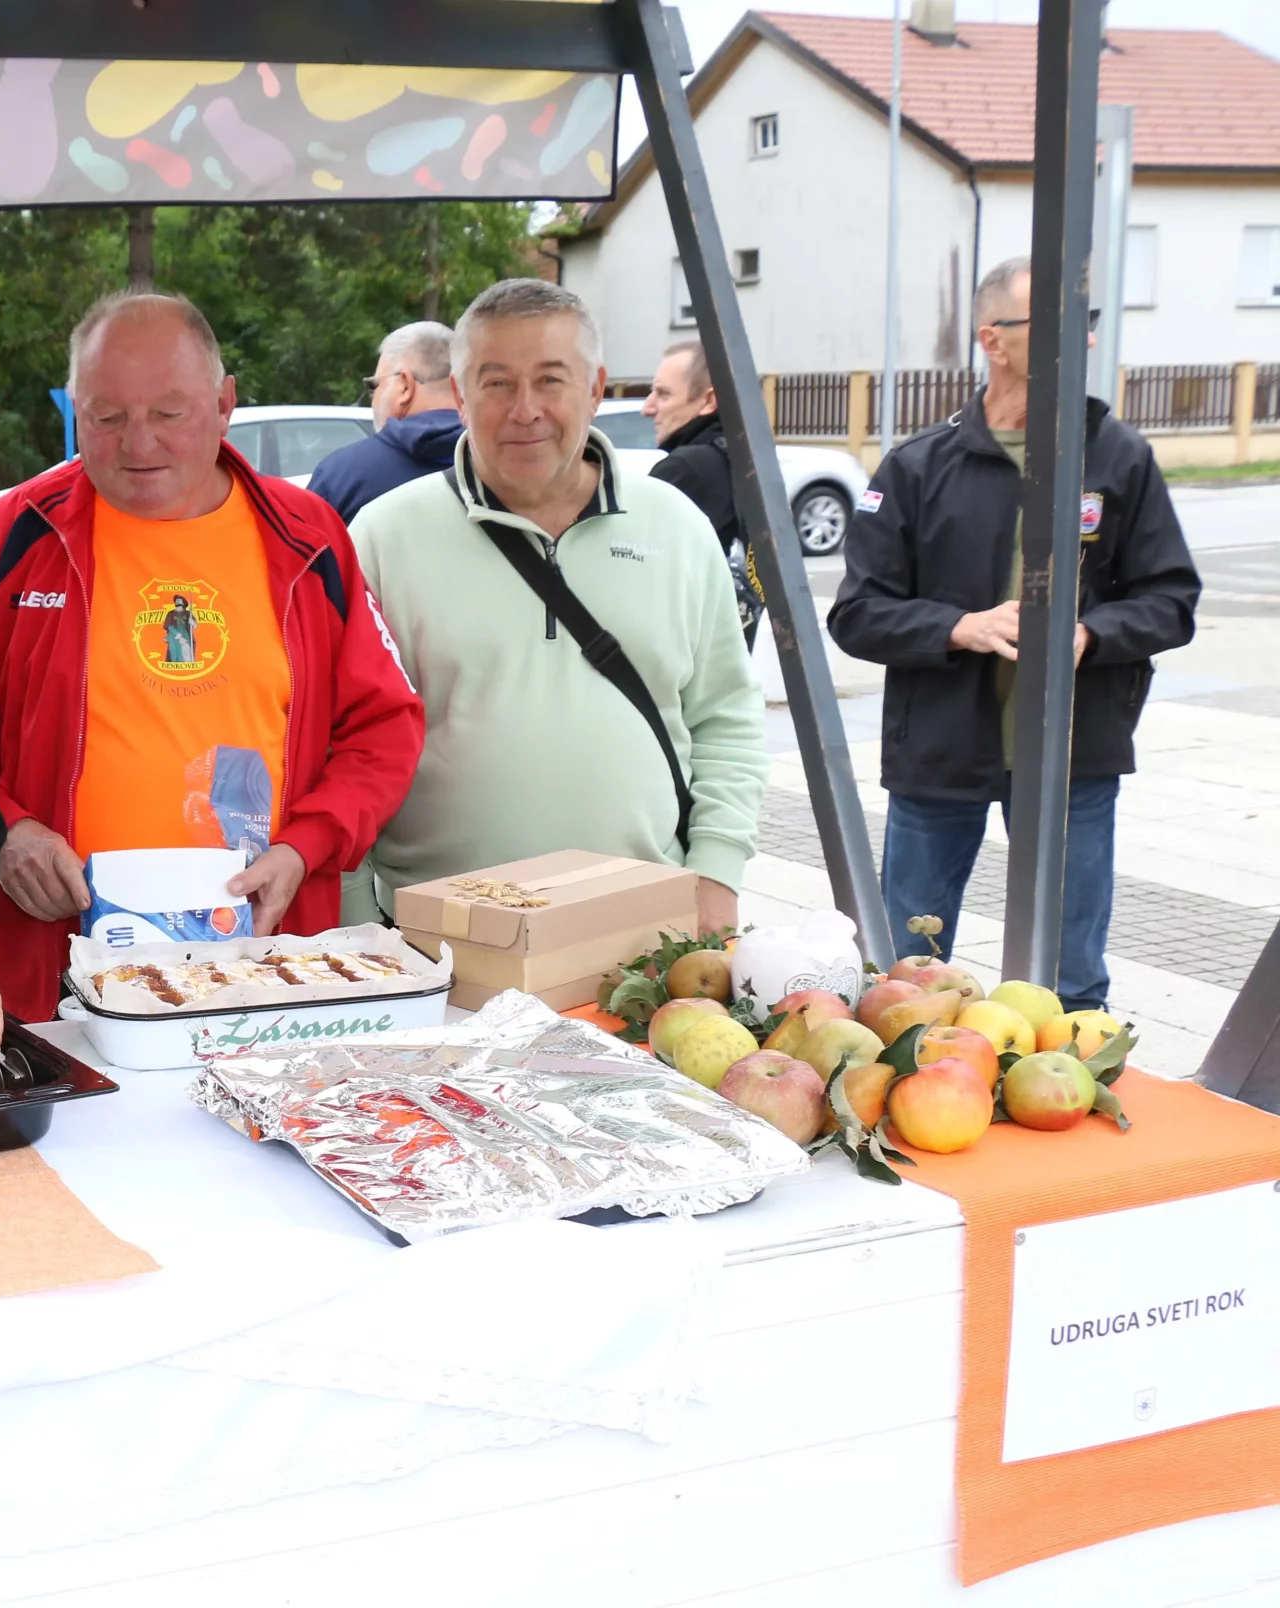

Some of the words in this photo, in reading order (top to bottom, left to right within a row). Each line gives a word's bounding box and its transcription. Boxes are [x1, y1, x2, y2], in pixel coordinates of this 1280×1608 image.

[136, 610, 165, 625] SVETI
[196, 609, 224, 624] ROK
[1050, 1311, 1140, 1346] UDRUGA
[1146, 1299, 1199, 1327] SVETI
[1205, 1288, 1246, 1314] ROK
